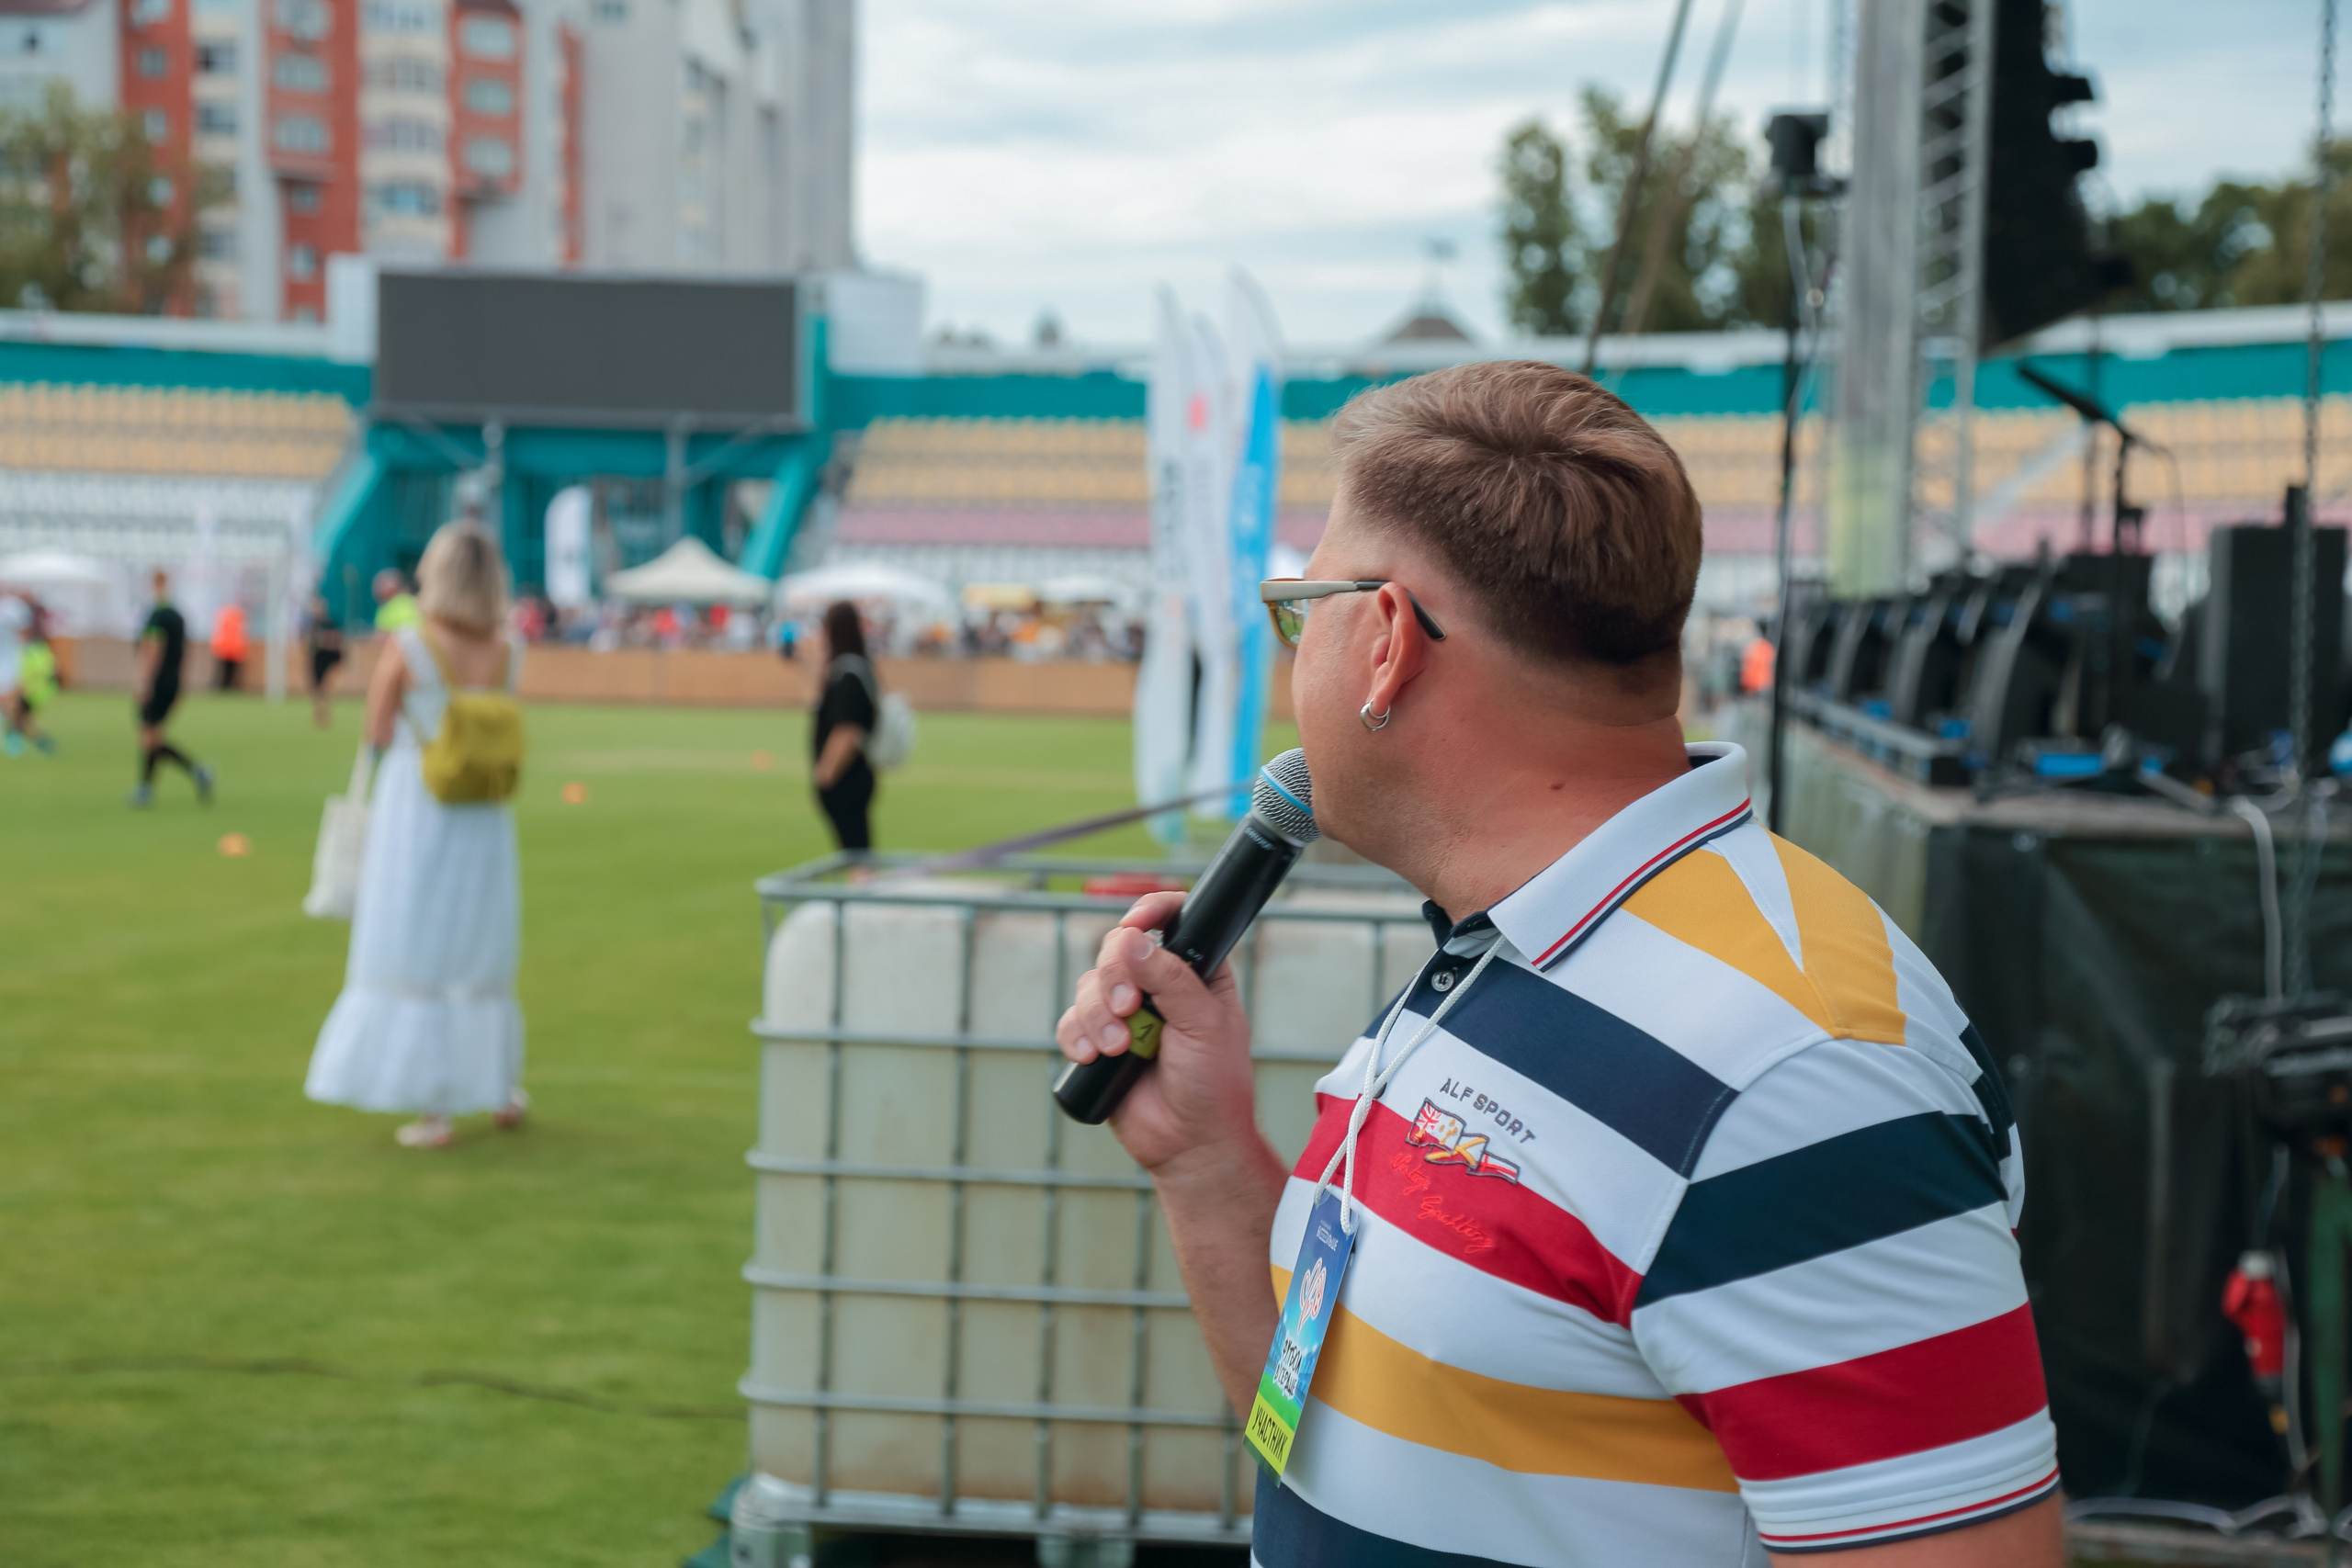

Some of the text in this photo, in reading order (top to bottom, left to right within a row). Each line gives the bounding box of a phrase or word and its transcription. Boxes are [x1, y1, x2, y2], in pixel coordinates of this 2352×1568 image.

[1439, 1077, 1537, 1145] ALF SPORT
[1251, 1404, 1289, 1463] УЧАСТНИК
